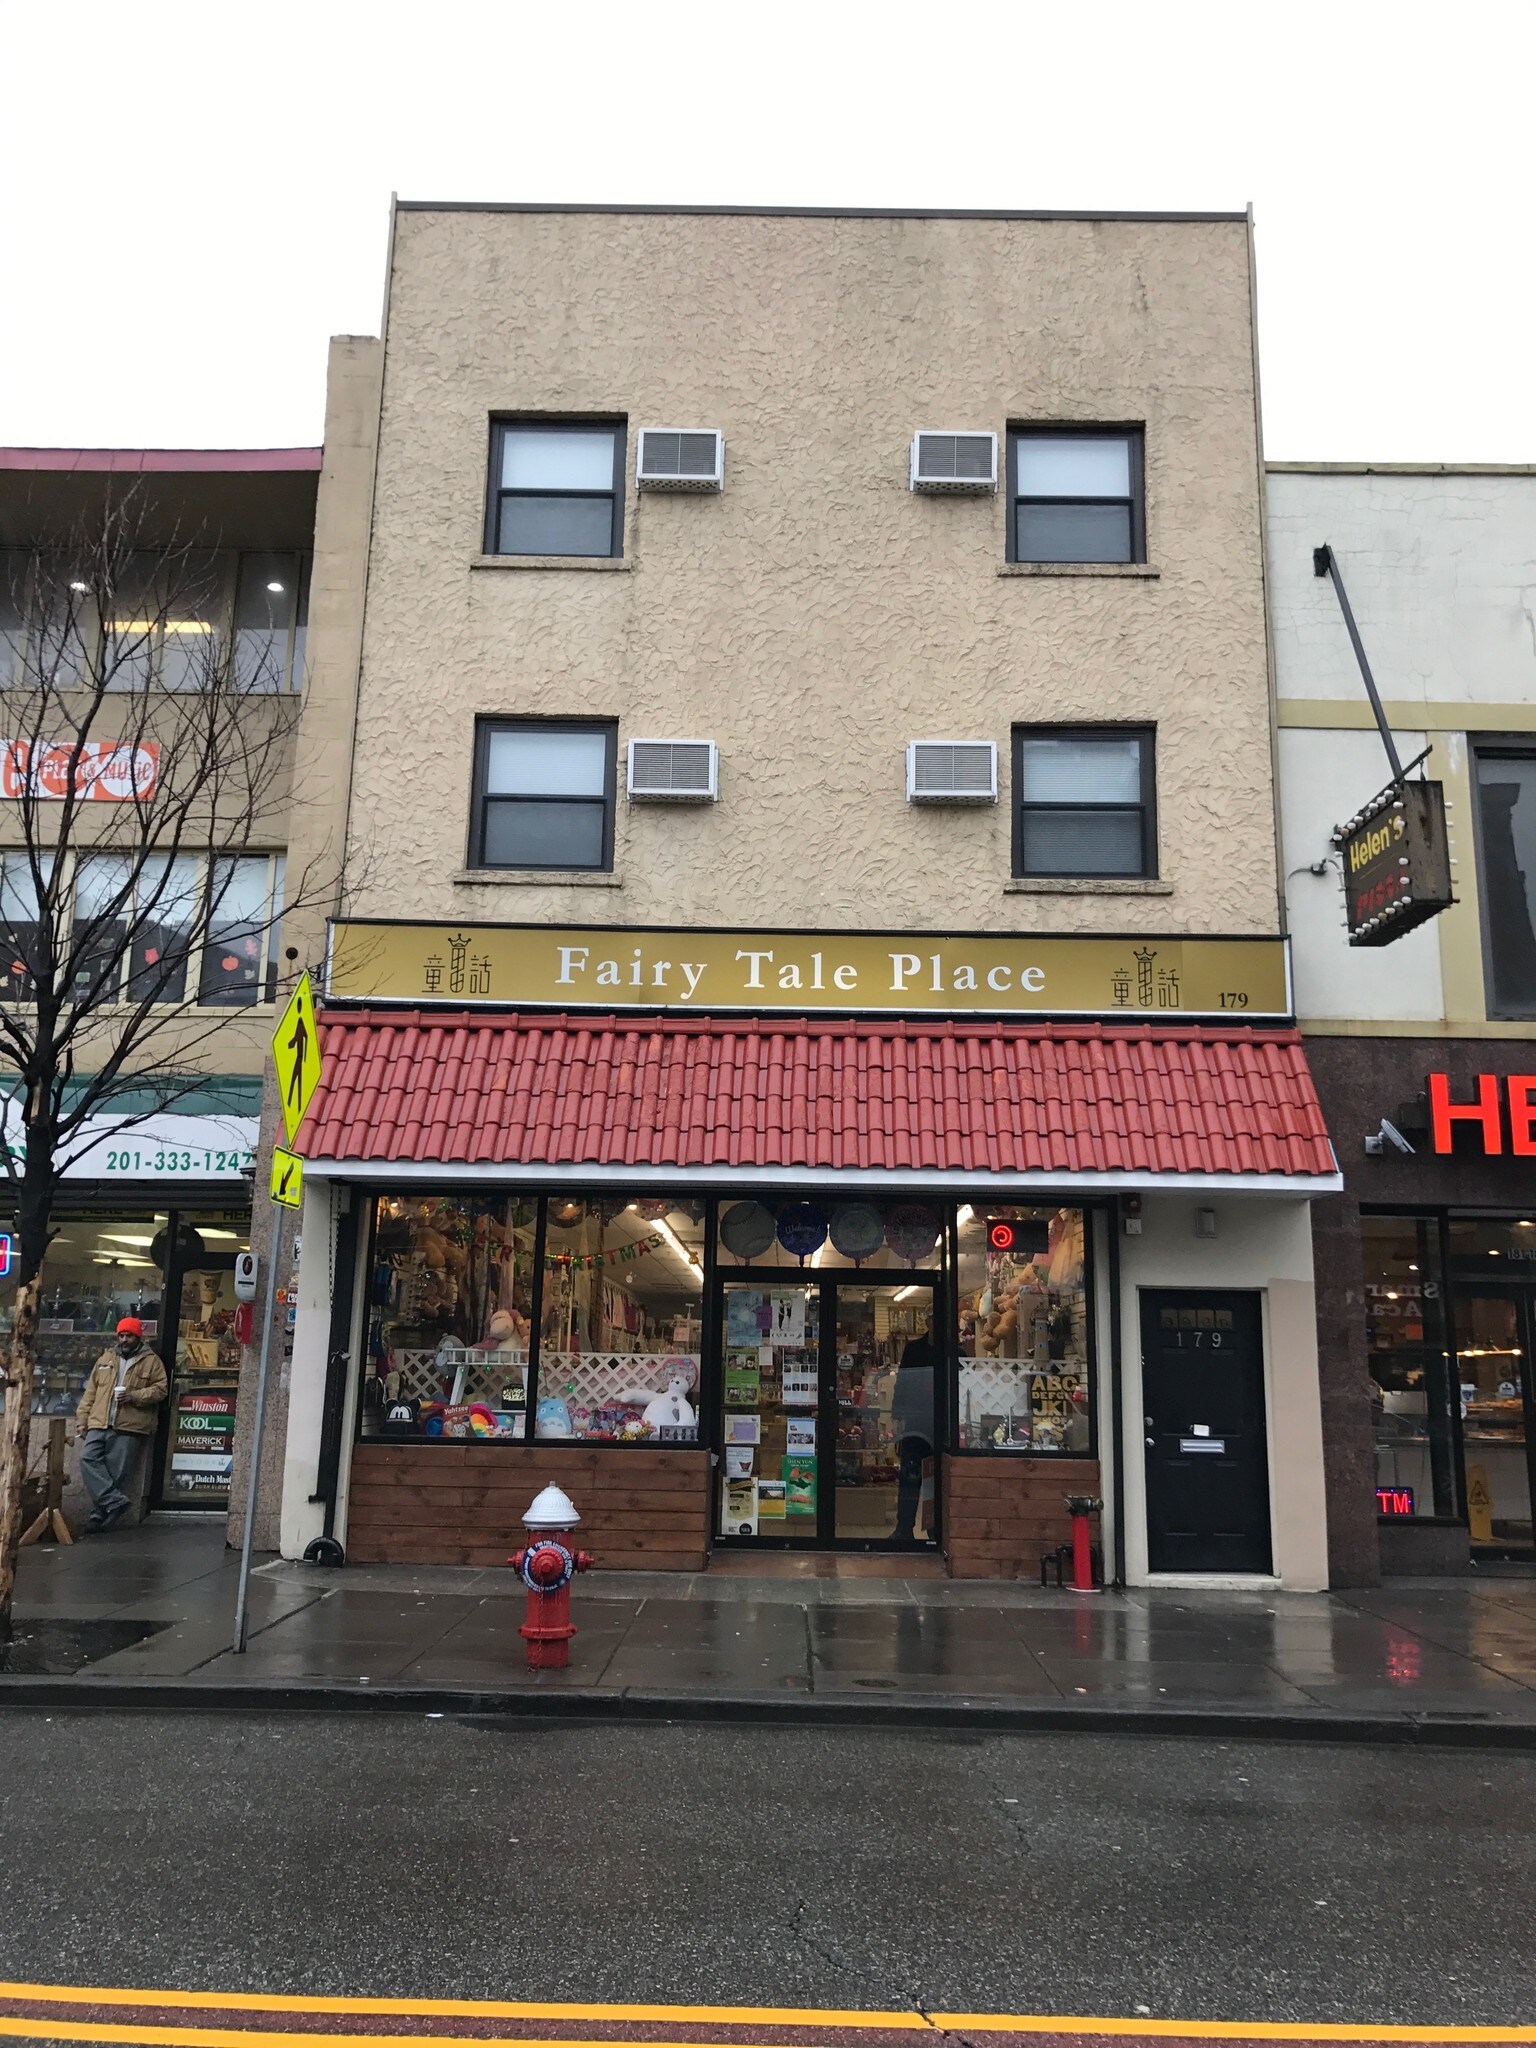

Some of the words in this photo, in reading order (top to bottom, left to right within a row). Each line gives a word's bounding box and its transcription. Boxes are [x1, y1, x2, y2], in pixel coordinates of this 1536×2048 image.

[42, 759, 81, 780] PLa
[1350, 815, 1405, 873] Helen's
[554, 946, 707, 1000] Fairy
[735, 949, 858, 990] Tale
[888, 953, 1046, 993] Place
[1218, 992, 1248, 1009] 179
[1176, 1331, 1222, 1348] 179
[191, 1399, 228, 1412] Winston
[444, 1405, 469, 1416] Yahtzee
[180, 1417, 212, 1430] KOOL
[178, 1436, 222, 1445] MAVERICK
[195, 1474, 215, 1483] Dutch
